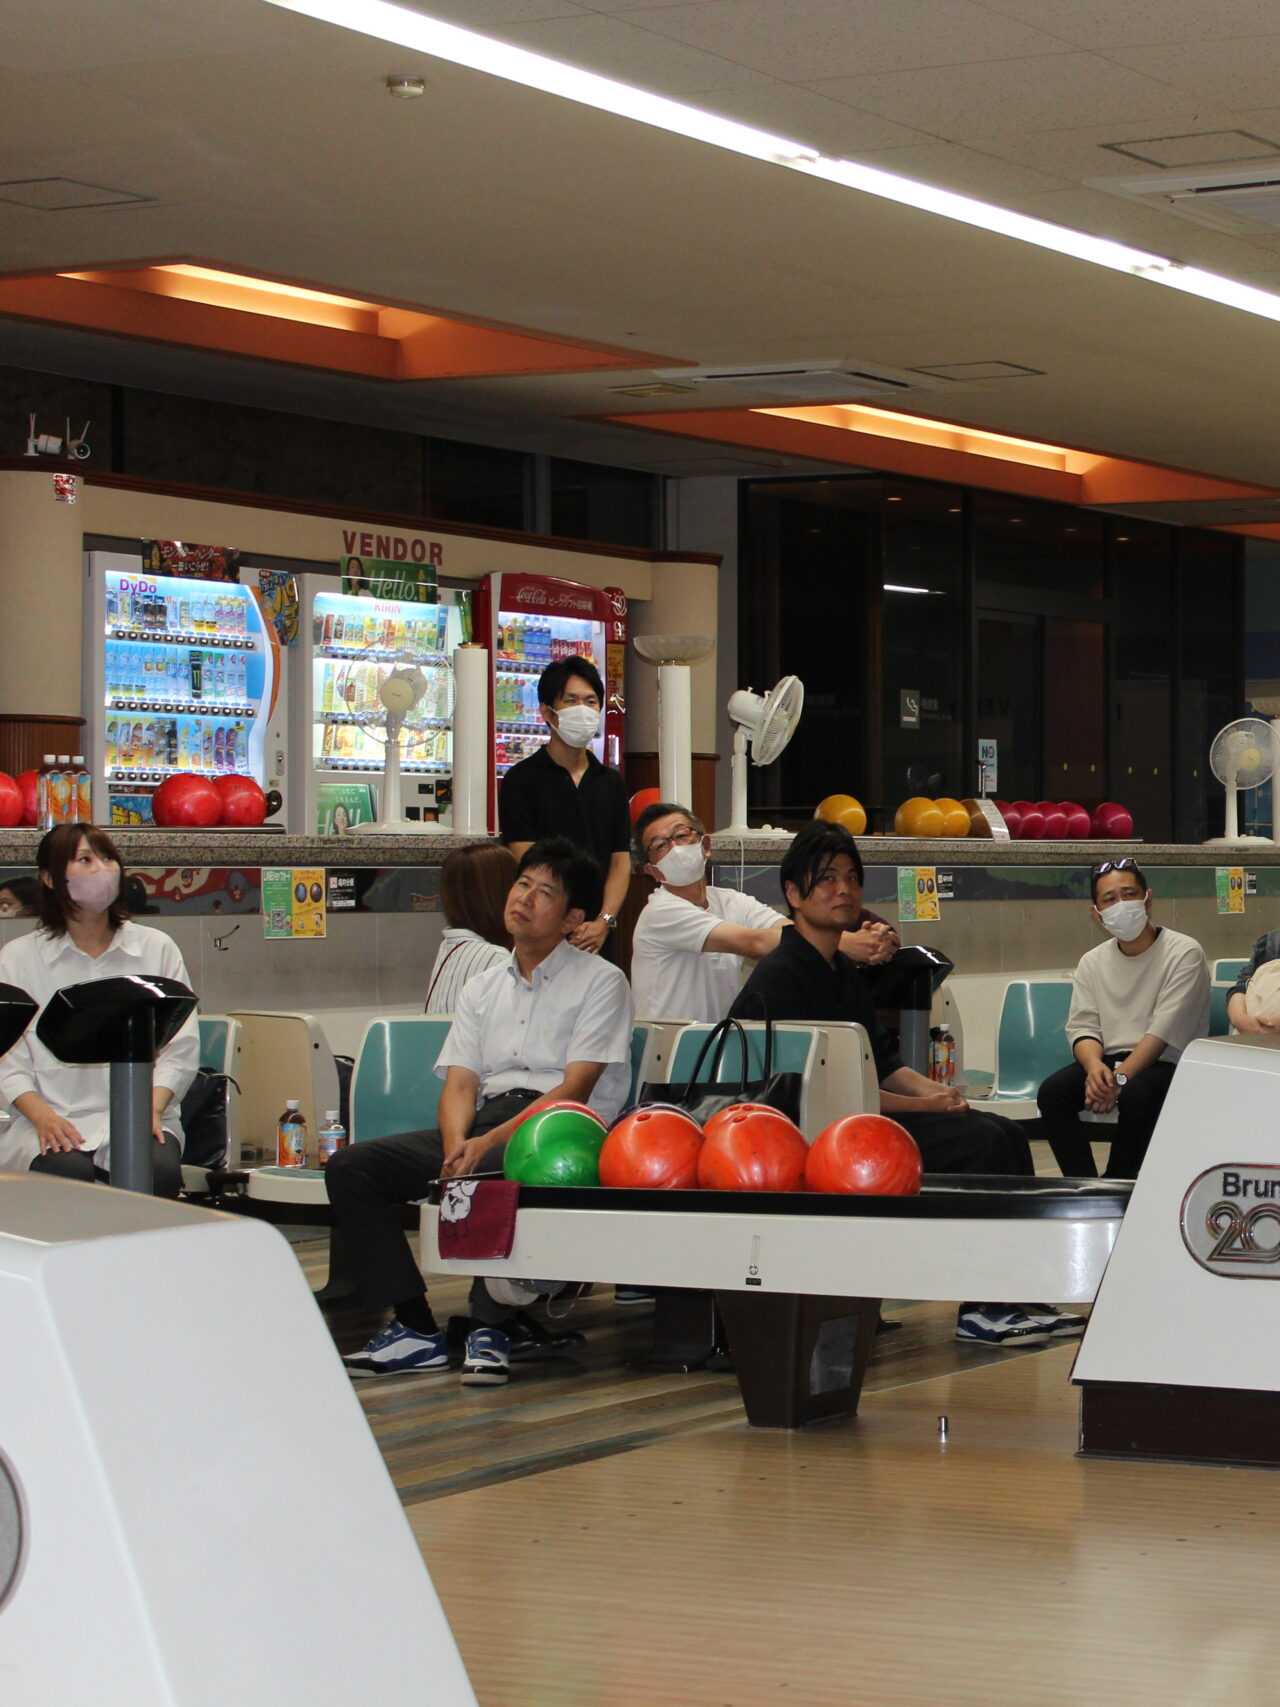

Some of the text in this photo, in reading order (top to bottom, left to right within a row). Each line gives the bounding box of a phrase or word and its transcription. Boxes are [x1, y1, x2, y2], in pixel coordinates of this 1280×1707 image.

[342, 530, 443, 566] VENDOR
[119, 579, 157, 595] DyDo
[374, 602, 401, 614] KIRIN
